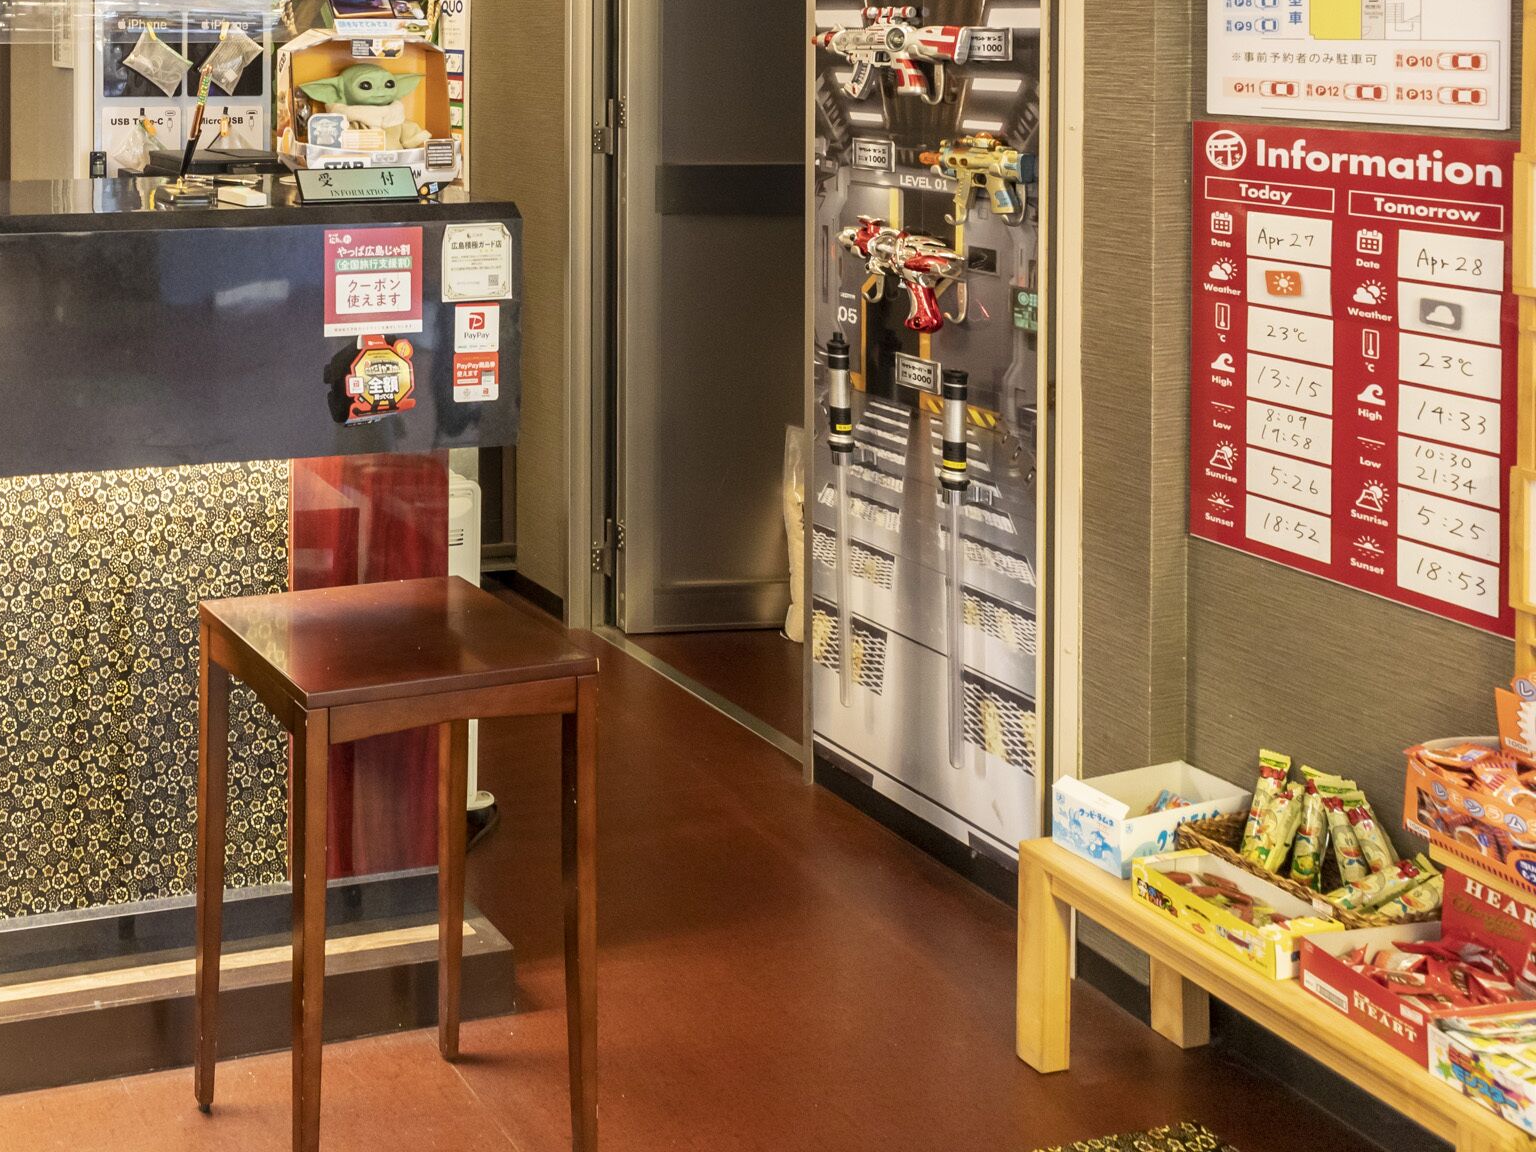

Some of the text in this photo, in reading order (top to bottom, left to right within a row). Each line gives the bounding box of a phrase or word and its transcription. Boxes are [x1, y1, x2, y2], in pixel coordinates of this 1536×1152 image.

[442, 0, 463, 17] QUO
[128, 19, 168, 30] iPhne
[1256, 138, 1503, 188] Information
[318, 170, 395, 188] 受付
[899, 174, 948, 191] LEVEL 01
[330, 188, 391, 197] INFORMATION
[1239, 183, 1292, 205] Today
[1373, 196, 1480, 222] Tomorrow
[451, 240, 502, 250] 広島積極ガード店
[1211, 238, 1231, 248] Date
[1258, 227, 1315, 251] Apr 27
[1355, 258, 1380, 270] Date
[1417, 248, 1483, 277] Apr 28
[348, 279, 401, 293] クーポン
[1204, 282, 1241, 296] Weather
[347, 292, 400, 308] 使えます
[837, 305, 858, 324] 05
[1347, 306, 1393, 322] Weather
[464, 331, 489, 340] PayPay
[368, 376, 399, 394] 全額
[1211, 375, 1232, 387] High
[1257, 366, 1321, 398] 13:15
[1266, 409, 1307, 429] 8:09
[1357, 407, 1382, 422] High
[1417, 401, 1486, 435] 14:33
[1213, 419, 1231, 430] Low
[1359, 456, 1381, 469] Low
[1415, 444, 1472, 469] 10:30
[1205, 468, 1237, 484] Sunrise
[1270, 466, 1319, 495] 5:26
[1416, 466, 1477, 494] 21:34
[1204, 512, 1234, 528] Sunset
[1350, 509, 1389, 528] Sunrise
[1417, 505, 1486, 540] 5:25
[1264, 512, 1320, 544] 18:52
[1350, 557, 1384, 575] Sunset
[1417, 557, 1486, 596] 18:53
[1353, 992, 1418, 1044] HEART
